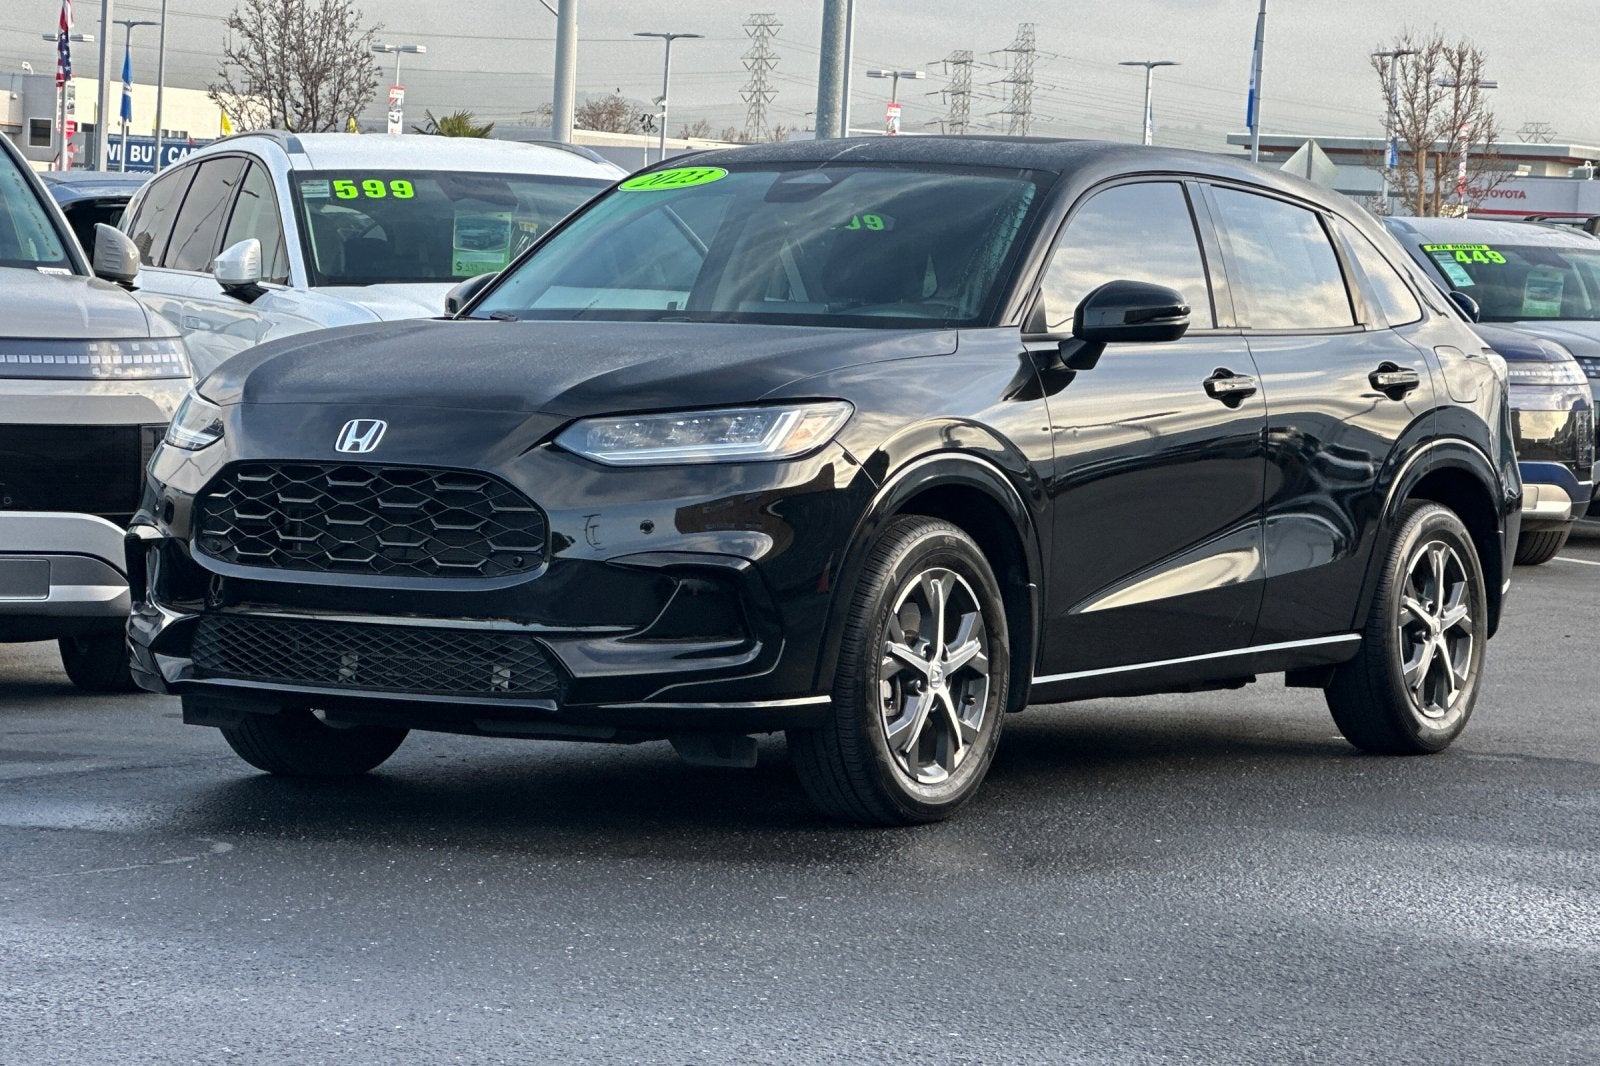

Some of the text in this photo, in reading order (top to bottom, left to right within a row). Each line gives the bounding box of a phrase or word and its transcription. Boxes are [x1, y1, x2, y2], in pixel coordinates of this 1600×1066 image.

[629, 169, 715, 188] 2023
[333, 179, 414, 199] 599
[1484, 189, 1526, 200] TOYOTA
[1455, 250, 1507, 264] 449
